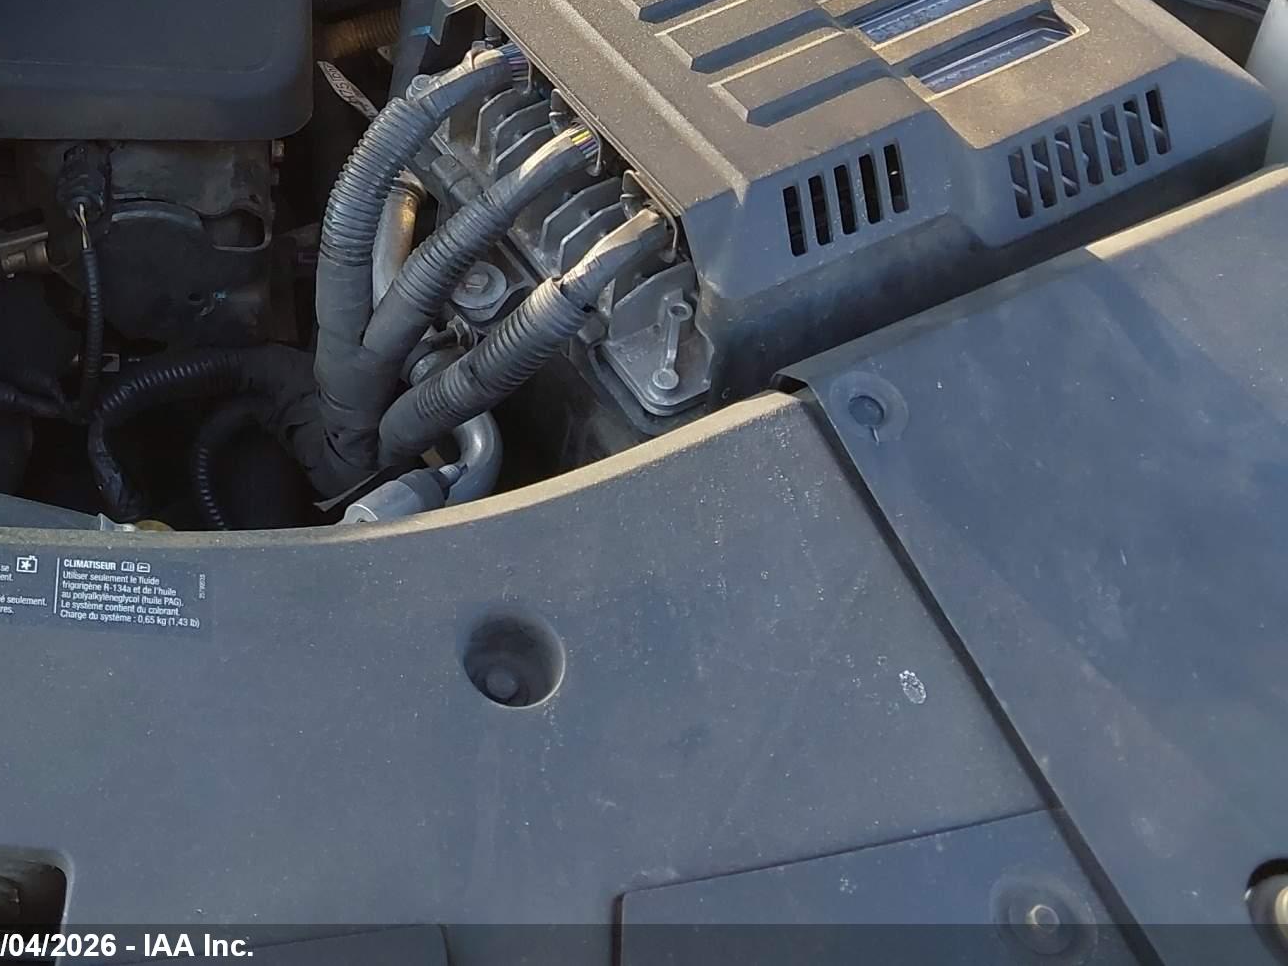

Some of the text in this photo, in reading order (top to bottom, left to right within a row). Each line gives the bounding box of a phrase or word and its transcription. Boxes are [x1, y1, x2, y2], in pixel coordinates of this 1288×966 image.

[0, 564, 10, 572] se
[63, 559, 117, 571] CLIMATISEUR
[62, 571, 160, 586] Utiliser seulement le fluide
[103, 583, 132, 593] R-134a
[132, 586, 141, 594] et
[142, 586, 152, 595] de
[61, 591, 72, 599] au
[141, 595, 162, 606] (huile
[60, 599, 71, 609] Le
[104, 603, 135, 614] contient
[136, 605, 147, 614] du
[60, 609, 87, 621] Charge
[88, 611, 99, 620] du
[156, 615, 167, 627] kg
